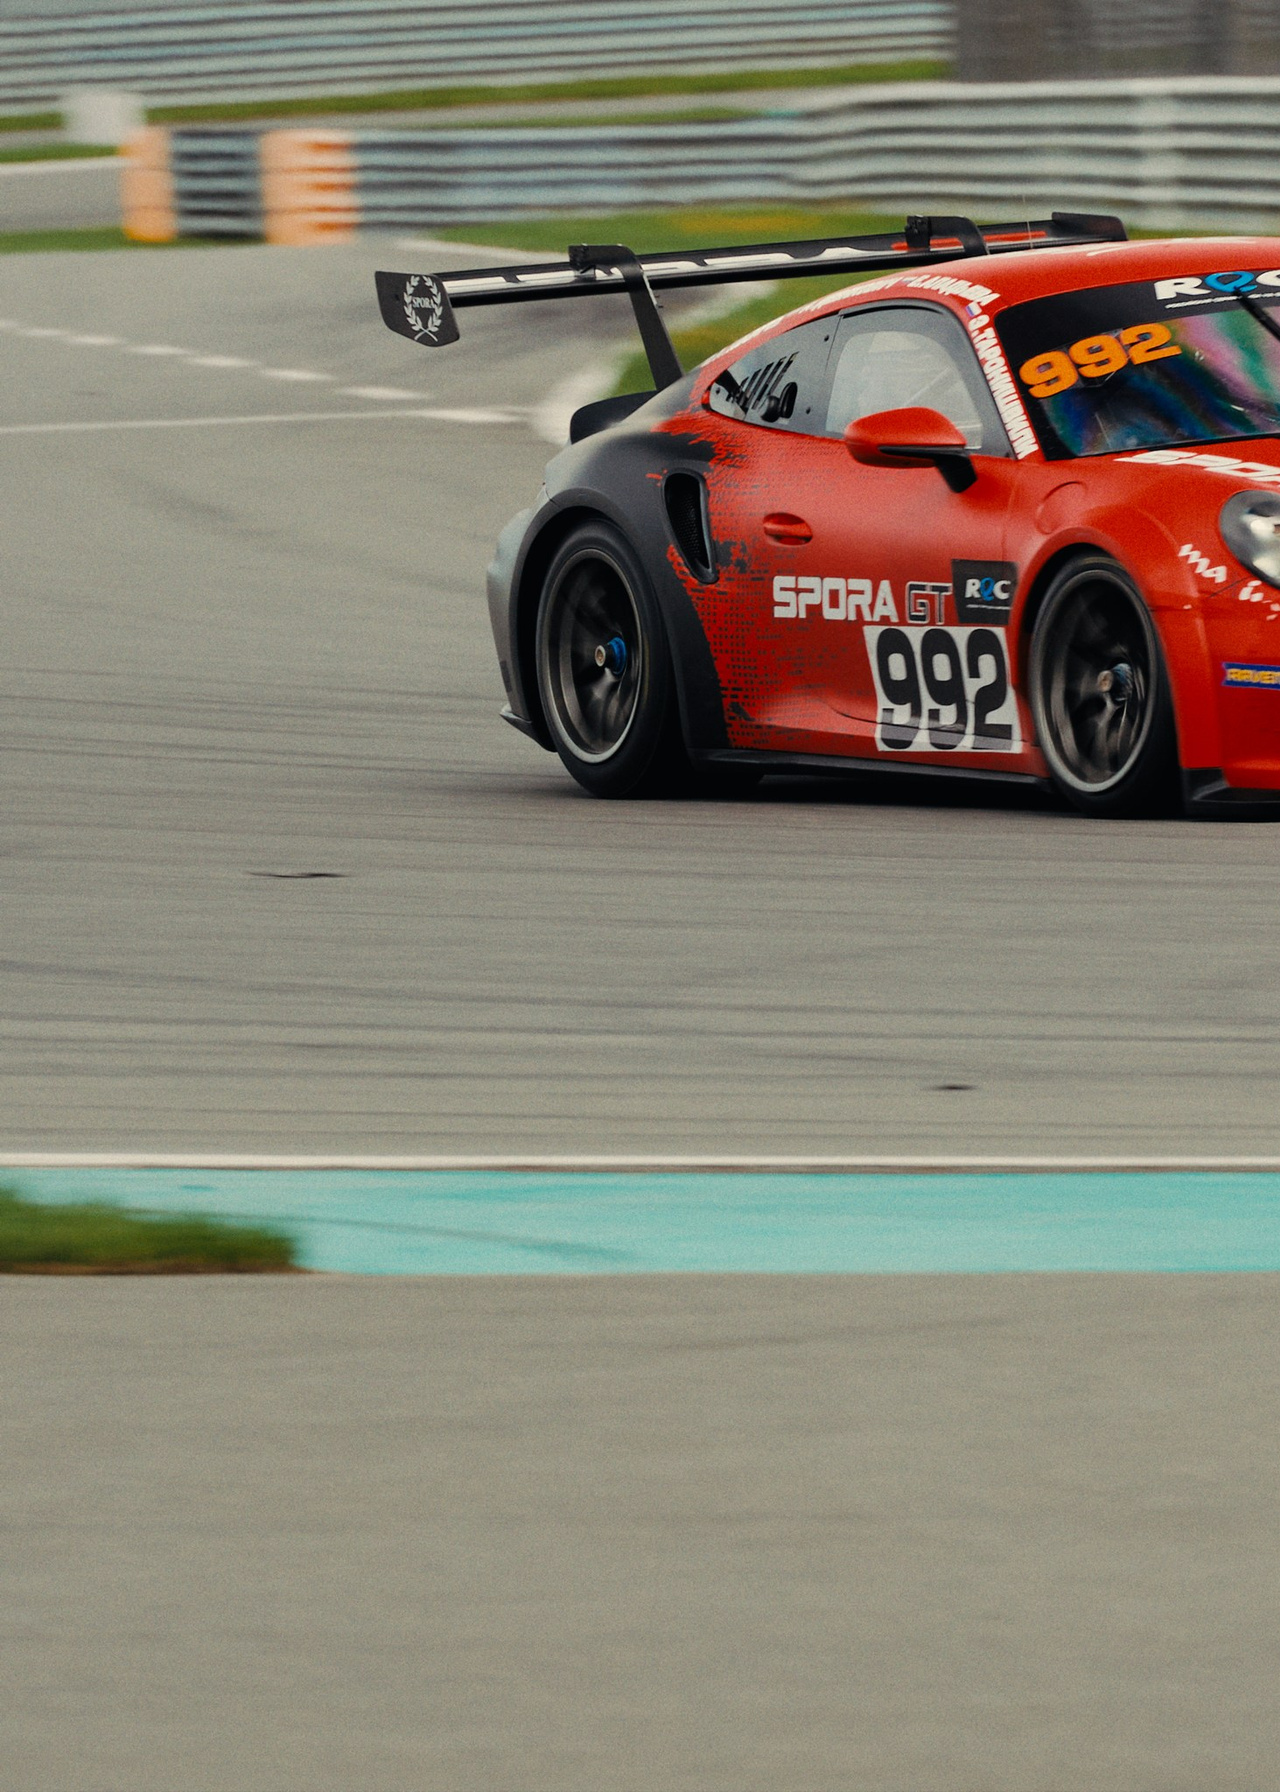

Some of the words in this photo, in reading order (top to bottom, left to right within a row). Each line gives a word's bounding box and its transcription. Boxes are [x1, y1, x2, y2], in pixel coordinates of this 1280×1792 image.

[1019, 323, 1182, 398] 992
[773, 576, 899, 623] SPORA
[906, 581, 953, 625] GT
[876, 628, 1013, 750] 992
